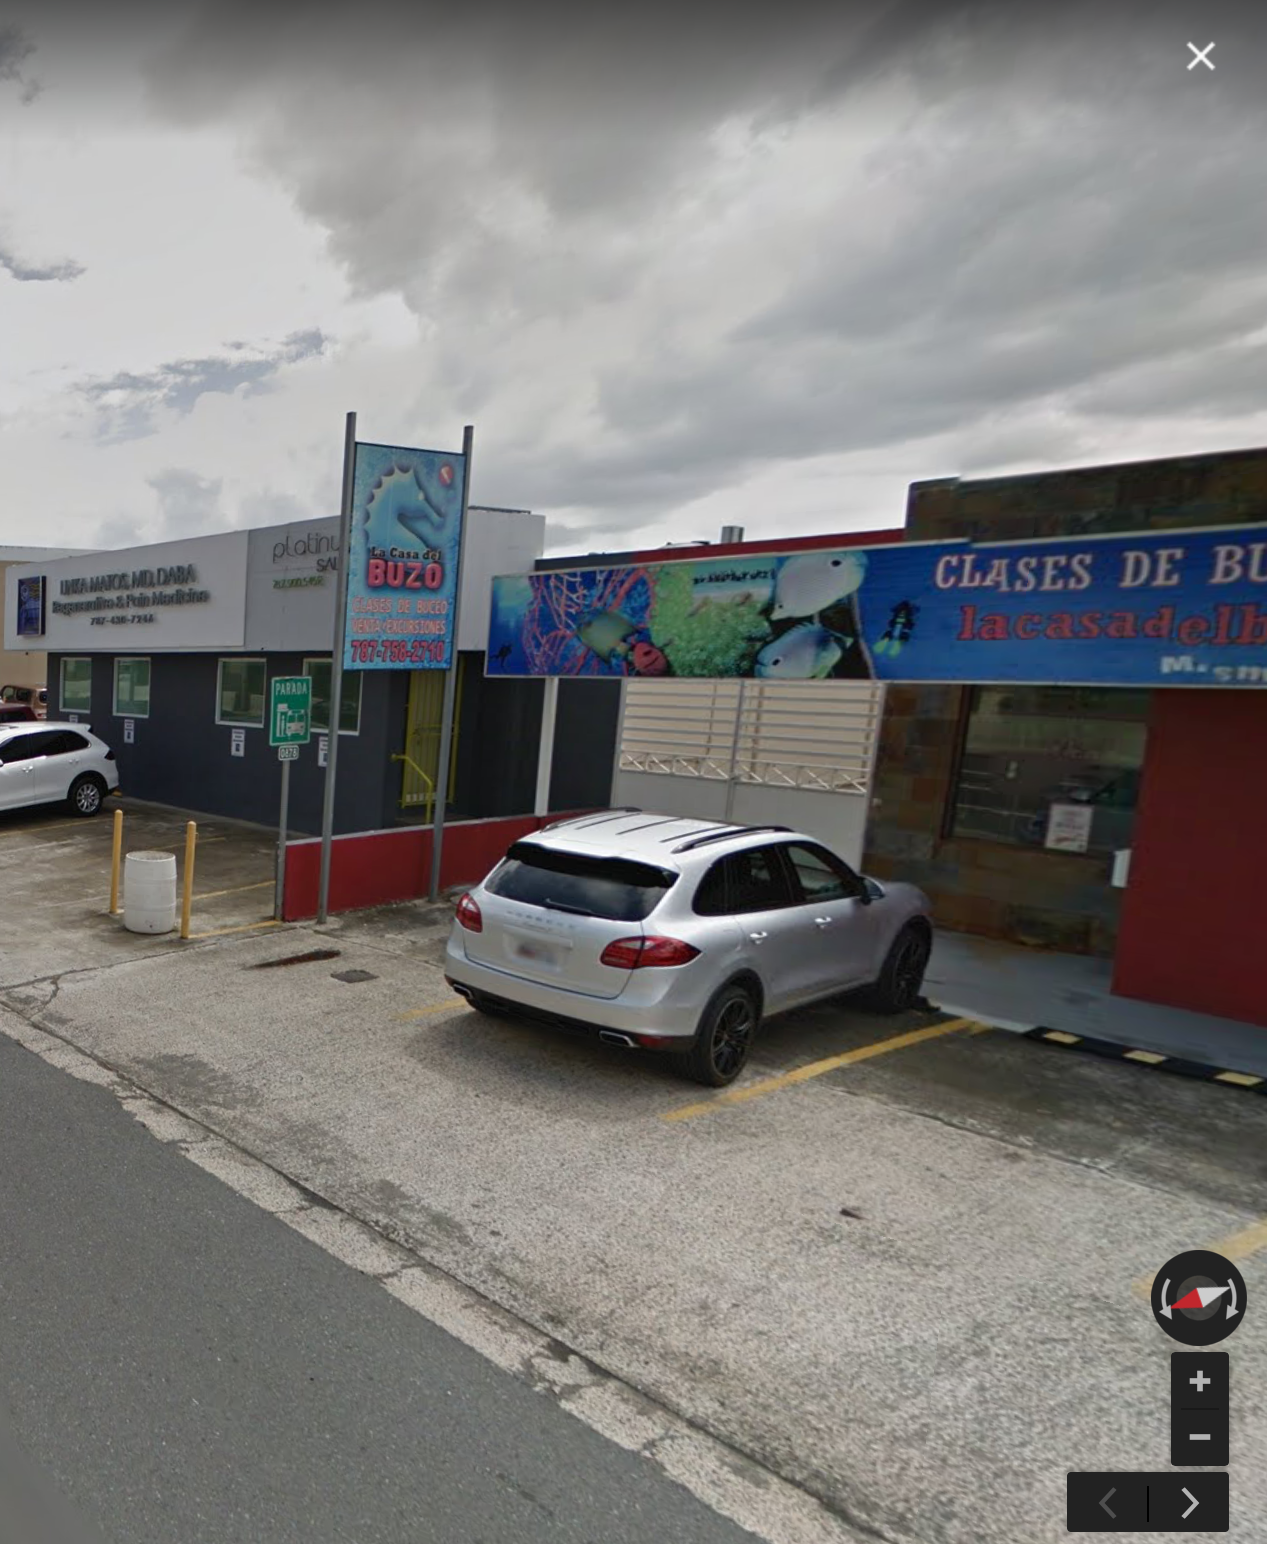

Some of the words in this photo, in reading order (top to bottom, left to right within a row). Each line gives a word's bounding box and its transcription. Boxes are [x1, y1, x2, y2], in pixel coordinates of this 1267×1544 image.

[272, 532, 340, 564] platinu
[371, 547, 385, 558] La
[389, 547, 419, 560] Casa
[422, 549, 442, 561] del
[316, 558, 340, 573] SAL
[367, 558, 443, 590] BUZO
[935, 552, 1094, 592] CLASES
[1119, 549, 1183, 588] DE
[351, 597, 392, 613] CLASES
[398, 600, 411, 613] DE
[417, 600, 448, 614] BUCEO
[351, 618, 382, 634] VENTA
[386, 619, 446, 635] EXCURSIONES
[351, 640, 446, 662] 787-758-2710
[275, 682, 307, 696] PARADA
